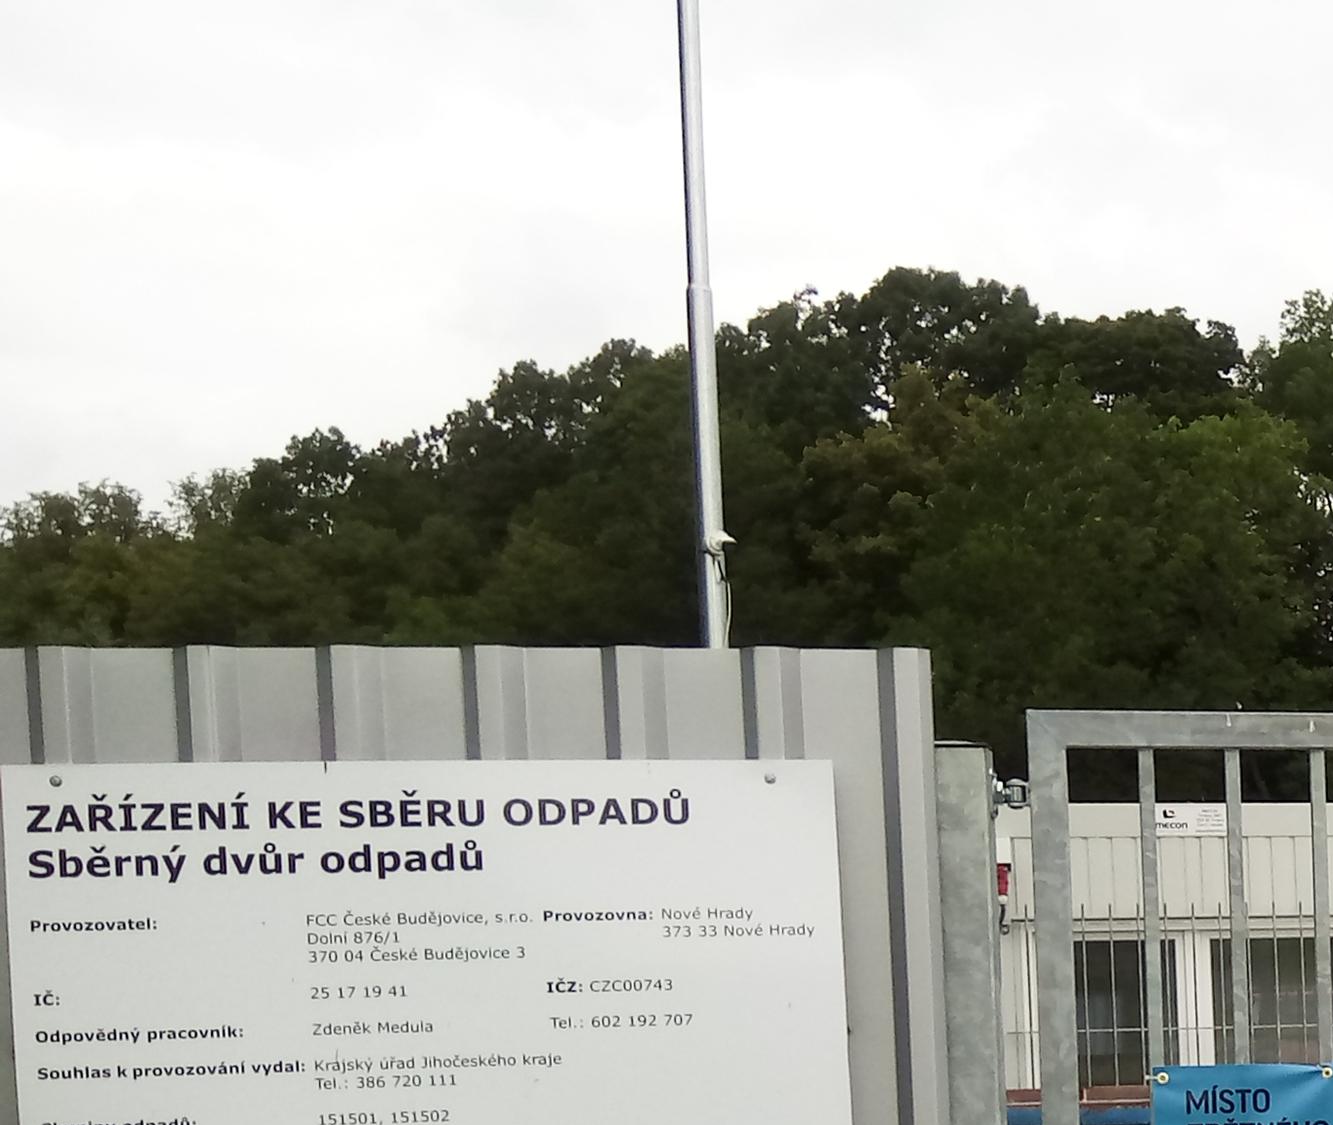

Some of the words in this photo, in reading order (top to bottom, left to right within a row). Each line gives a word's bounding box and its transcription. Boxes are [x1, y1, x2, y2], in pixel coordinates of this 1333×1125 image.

[26, 792, 250, 833] ZAŘÍZENÍ
[268, 800, 322, 829] KE
[339, 790, 485, 828] SBĚRU
[503, 789, 690, 825] ODPADŮ
[28, 845, 186, 883] Sběrný
[203, 843, 304, 875] dvůr
[320, 840, 483, 879] odpadů
[306, 914, 337, 926] FCC
[343, 911, 391, 926] České
[397, 912, 488, 926] Budějovice,
[495, 913, 533, 924] s.r.o.
[543, 909, 653, 922] Provozovna:
[661, 907, 701, 920] Nové
[707, 907, 753, 921] Hrady
[30, 918, 157, 932] Provozovatel:
[663, 925, 692, 938] 373
[698, 925, 717, 937] 33
[724, 923, 763, 937] Nové
[769, 923, 815, 938] Hrady
[307, 932, 347, 945] Dolní
[353, 931, 400, 945] 876/1
[308, 950, 338, 963] 370
[344, 950, 364, 962] 04
[370, 946, 418, 962] České
[424, 948, 510, 963] Budějovice
[516, 947, 526, 959] 3
[311, 987, 330, 999] 25
[337, 986, 355, 998] 17
[364, 986, 382, 998] 19
[388, 985, 408, 997] 41
[546, 977, 583, 993] IČZ:
[589, 979, 673, 992] CZC00743
[33, 990, 60, 1006] IČ:
[312, 1020, 371, 1036] Zdeněk
[378, 1020, 433, 1033] Medula
[550, 1016, 584, 1029] Tel.:
[591, 1014, 621, 1028] 602
[629, 1014, 657, 1027] 192
[664, 1013, 693, 1026] 707
[35, 1027, 140, 1045] Odpovědný
[147, 1025, 244, 1043] pracovník:
[37, 1065, 111, 1080] Souhlas
[117, 1065, 127, 1078] k
[133, 1060, 245, 1080] provozování
[252, 1060, 305, 1076] vydal:
[314, 1056, 373, 1073] Krajský
[380, 1055, 415, 1070] úřad
[421, 1053, 516, 1069] Jihočeského
[522, 1053, 562, 1068] kraje
[315, 1077, 349, 1090] Tel.:
[356, 1076, 386, 1088] 386
[392, 1075, 421, 1087] 720
[429, 1074, 457, 1086] 111
[1186, 1085, 1271, 1115] MÍSTO
[391, 1109, 450, 1124] 151502
